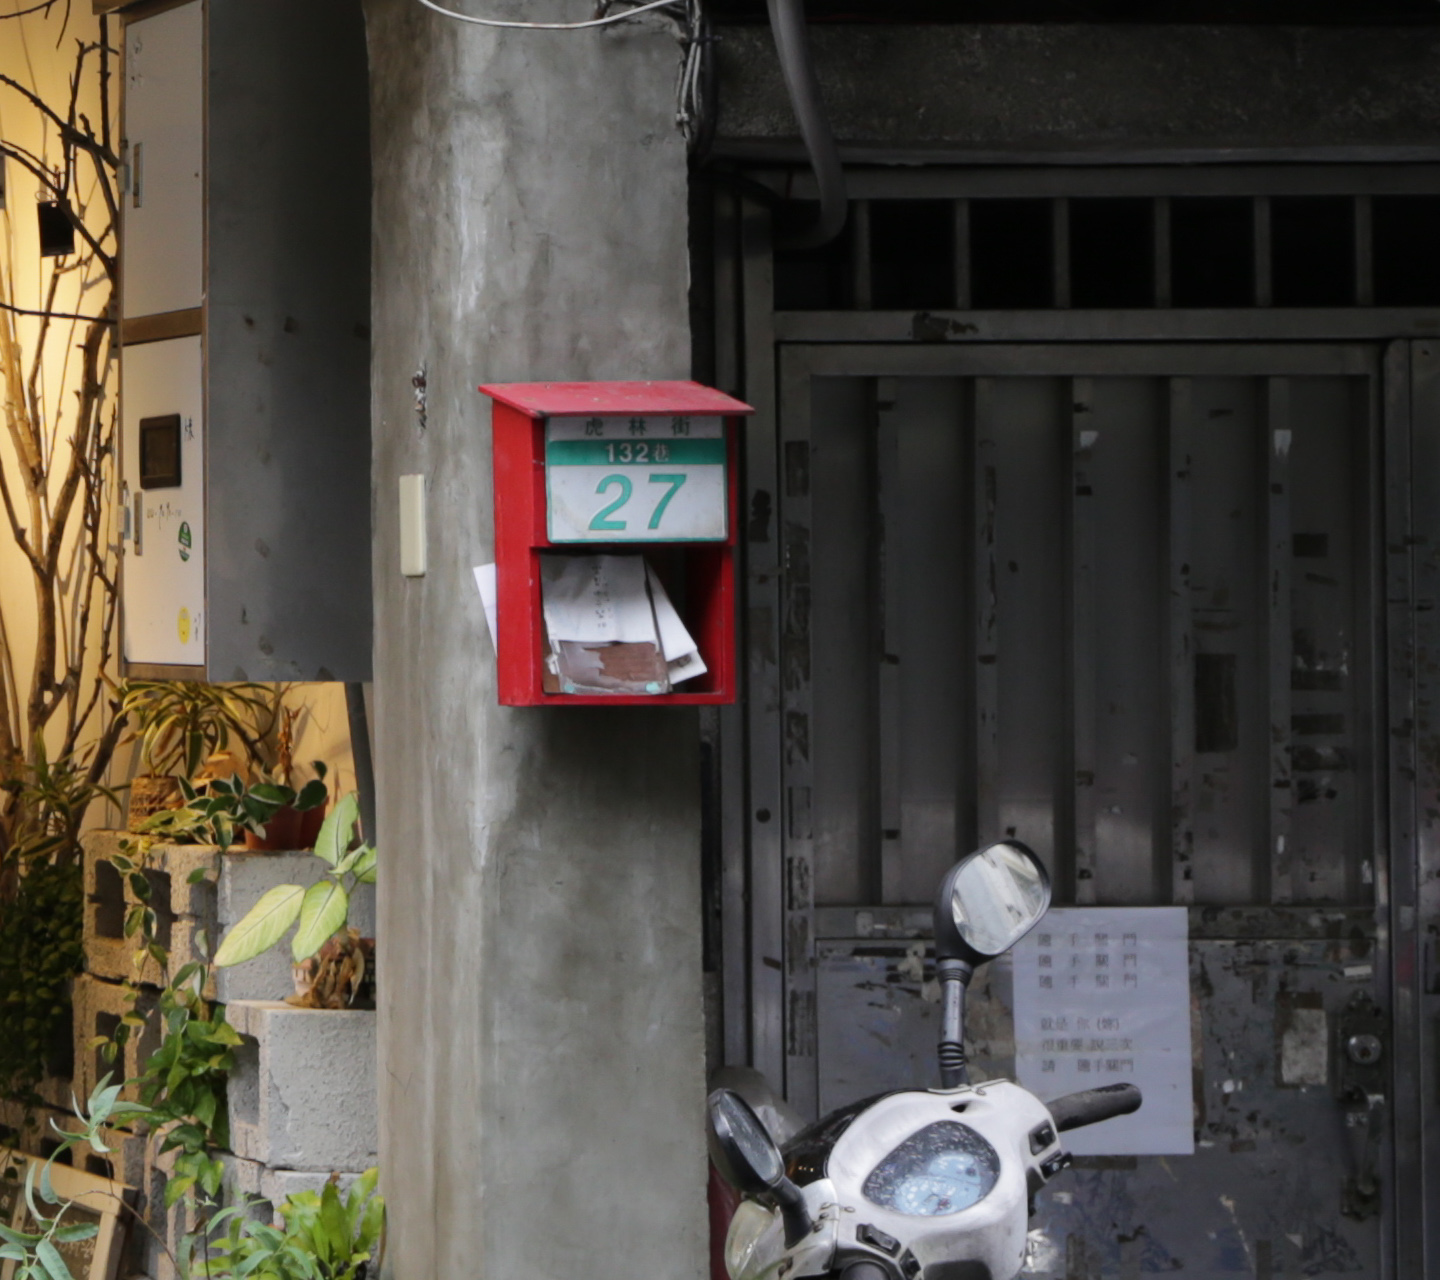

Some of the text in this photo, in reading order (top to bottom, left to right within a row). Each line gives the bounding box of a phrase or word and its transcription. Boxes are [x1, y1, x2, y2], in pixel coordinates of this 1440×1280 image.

[584, 417, 691, 438] 虎林街
[605, 443, 670, 463] 132巷
[588, 473, 688, 531] 27
